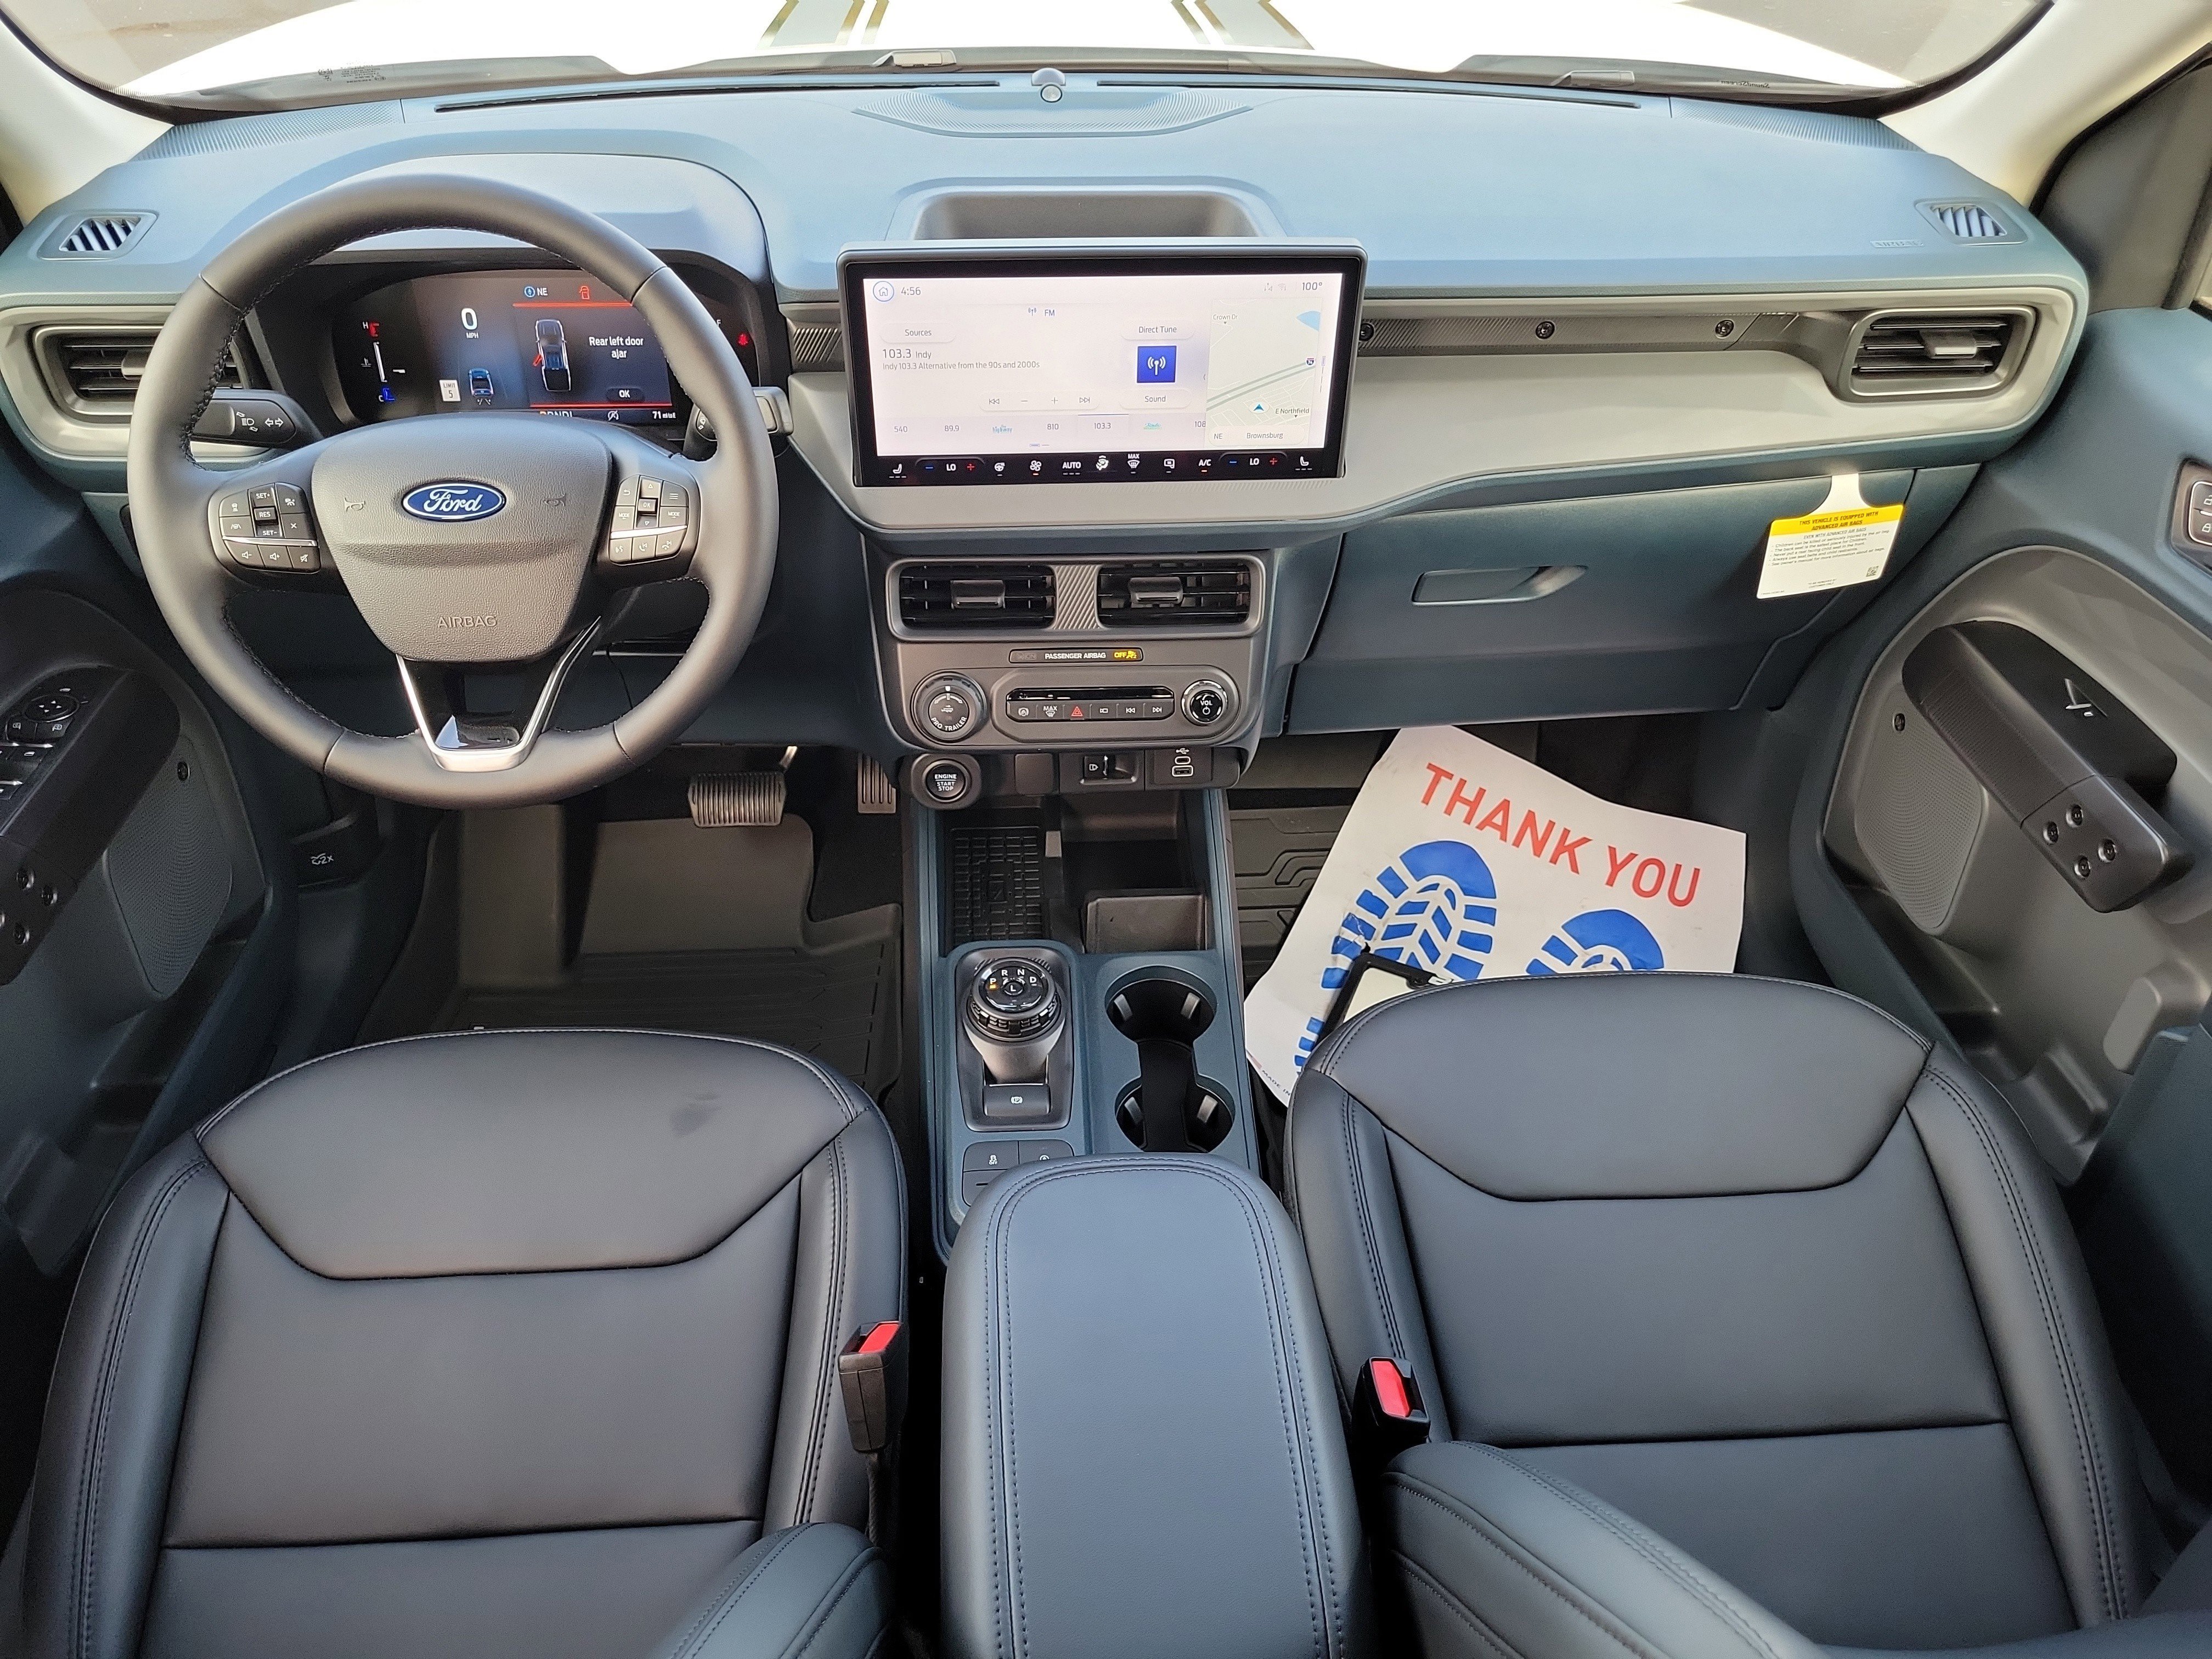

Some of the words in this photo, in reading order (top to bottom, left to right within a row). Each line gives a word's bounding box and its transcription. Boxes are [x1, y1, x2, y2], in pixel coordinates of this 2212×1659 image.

[537, 288, 548, 296] NE
[901, 287, 921, 296] 4:56
[461, 308, 477, 330] 0
[589, 336, 608, 346] Rear
[610, 336, 624, 346] left
[625, 336, 644, 346] door
[612, 349, 627, 359] ajar
[883, 349, 912, 358] 103.3
[916, 351, 932, 359] Indy
[424, 489, 483, 512] Ford
[438, 616, 497, 628] AIRBAG
[931, 716, 943, 729] PRO
[945, 716, 967, 731] TRAILER
[1421, 763, 1593, 875] THANK
[1605, 845, 1700, 907] YOU
[1262, 1070, 1280, 1088] MADE
